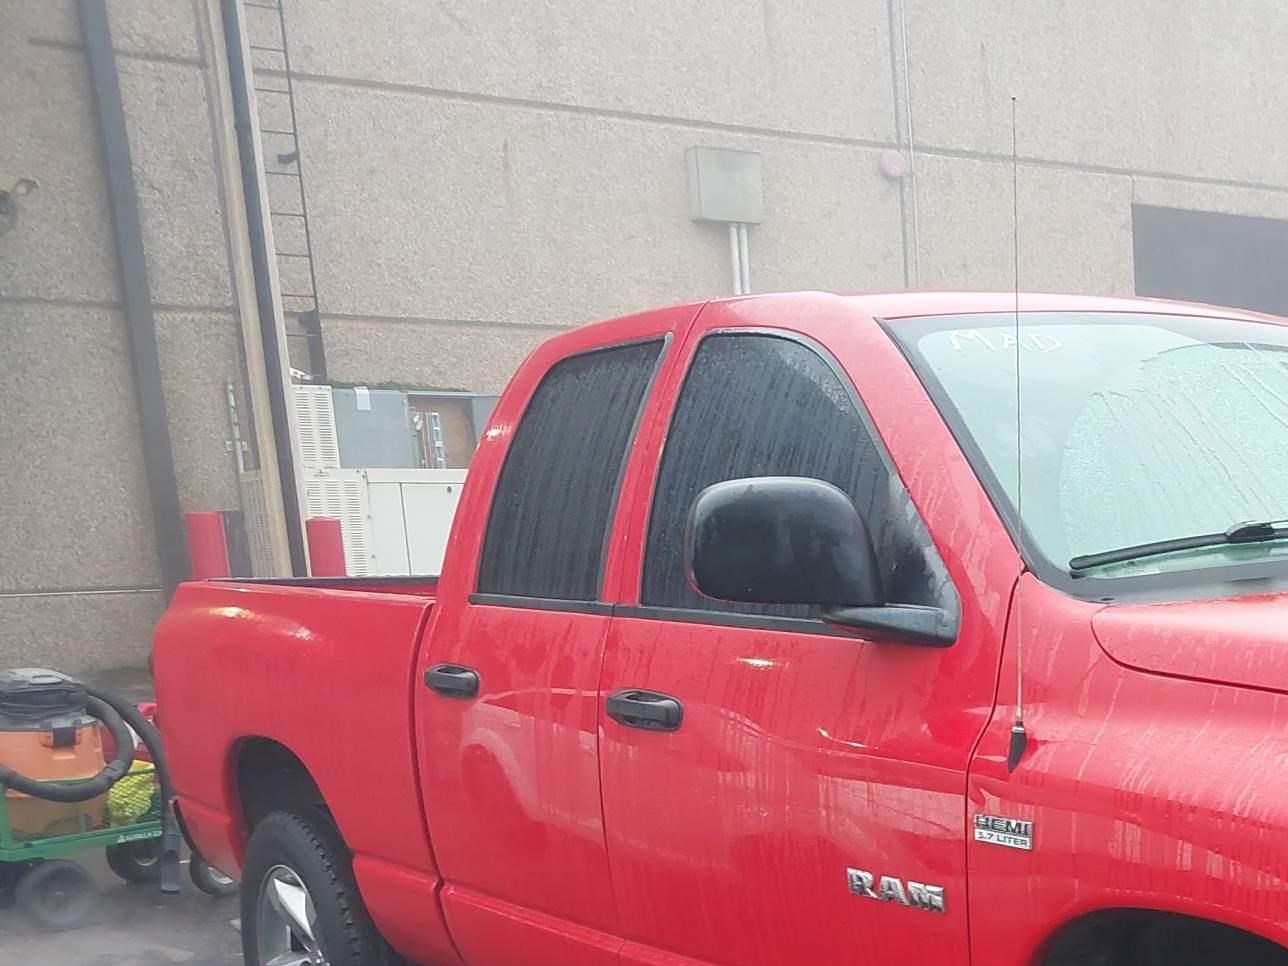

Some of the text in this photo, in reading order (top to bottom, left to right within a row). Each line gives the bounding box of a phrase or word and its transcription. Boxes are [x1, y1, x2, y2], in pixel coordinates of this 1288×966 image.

[975, 815, 1030, 836] HEMI
[977, 831, 1028, 848] 5.7 LITER
[847, 867, 944, 912] RAM
